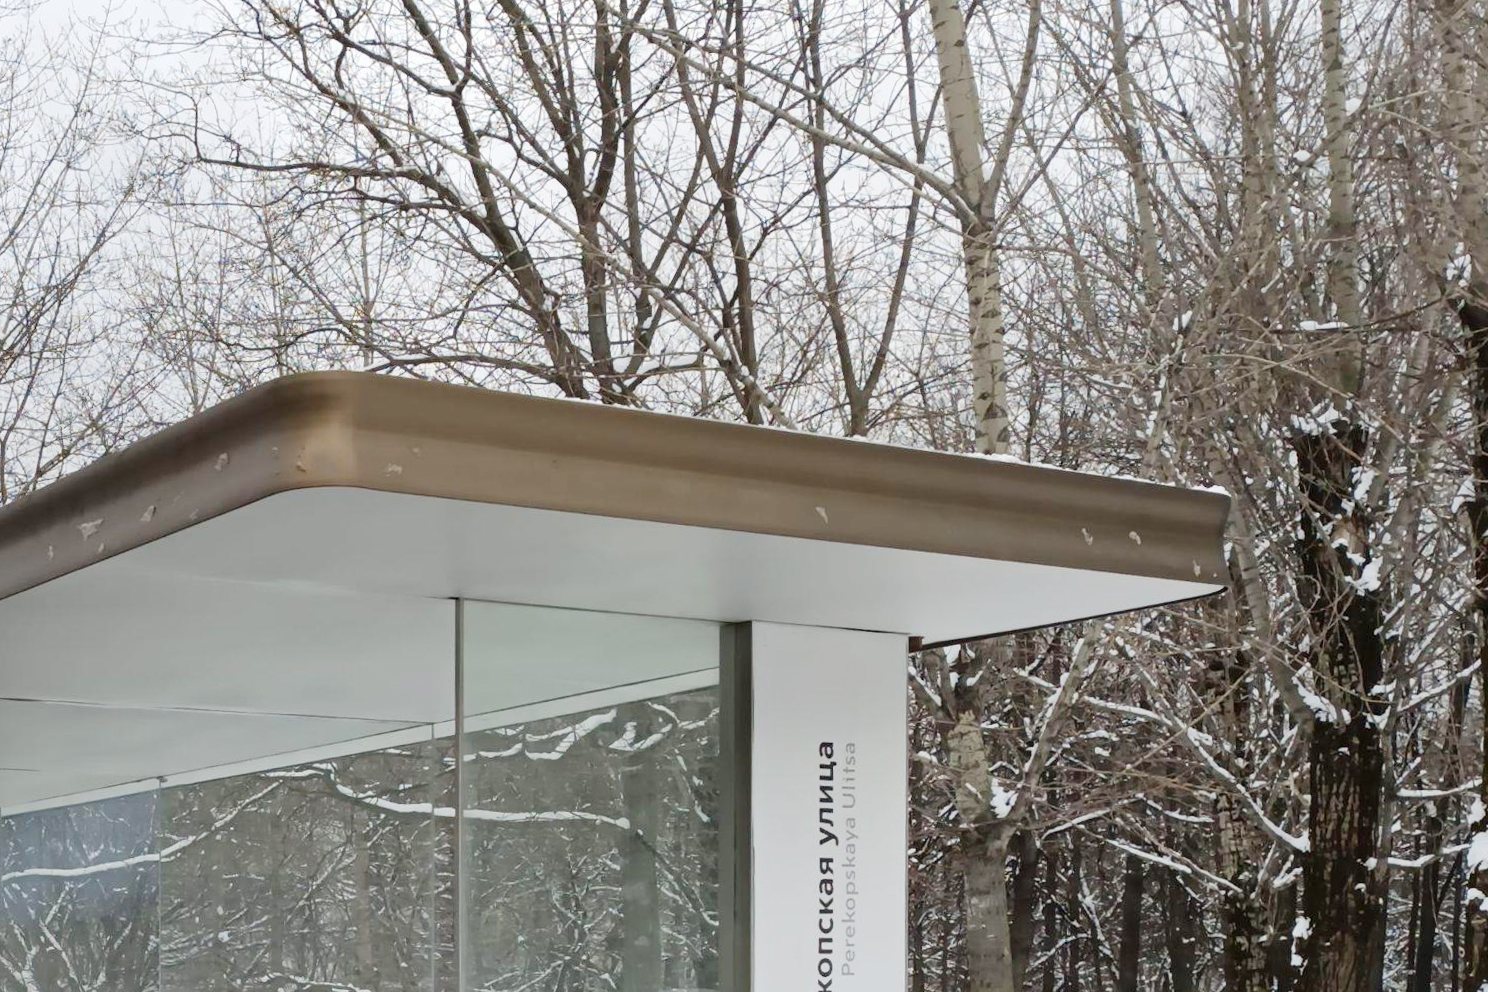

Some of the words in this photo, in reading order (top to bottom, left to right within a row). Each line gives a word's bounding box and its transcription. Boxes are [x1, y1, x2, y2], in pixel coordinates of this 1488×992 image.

[819, 741, 839, 846] улица
[841, 742, 856, 808] Ulitsa
[841, 817, 858, 976] Perekopskaya
